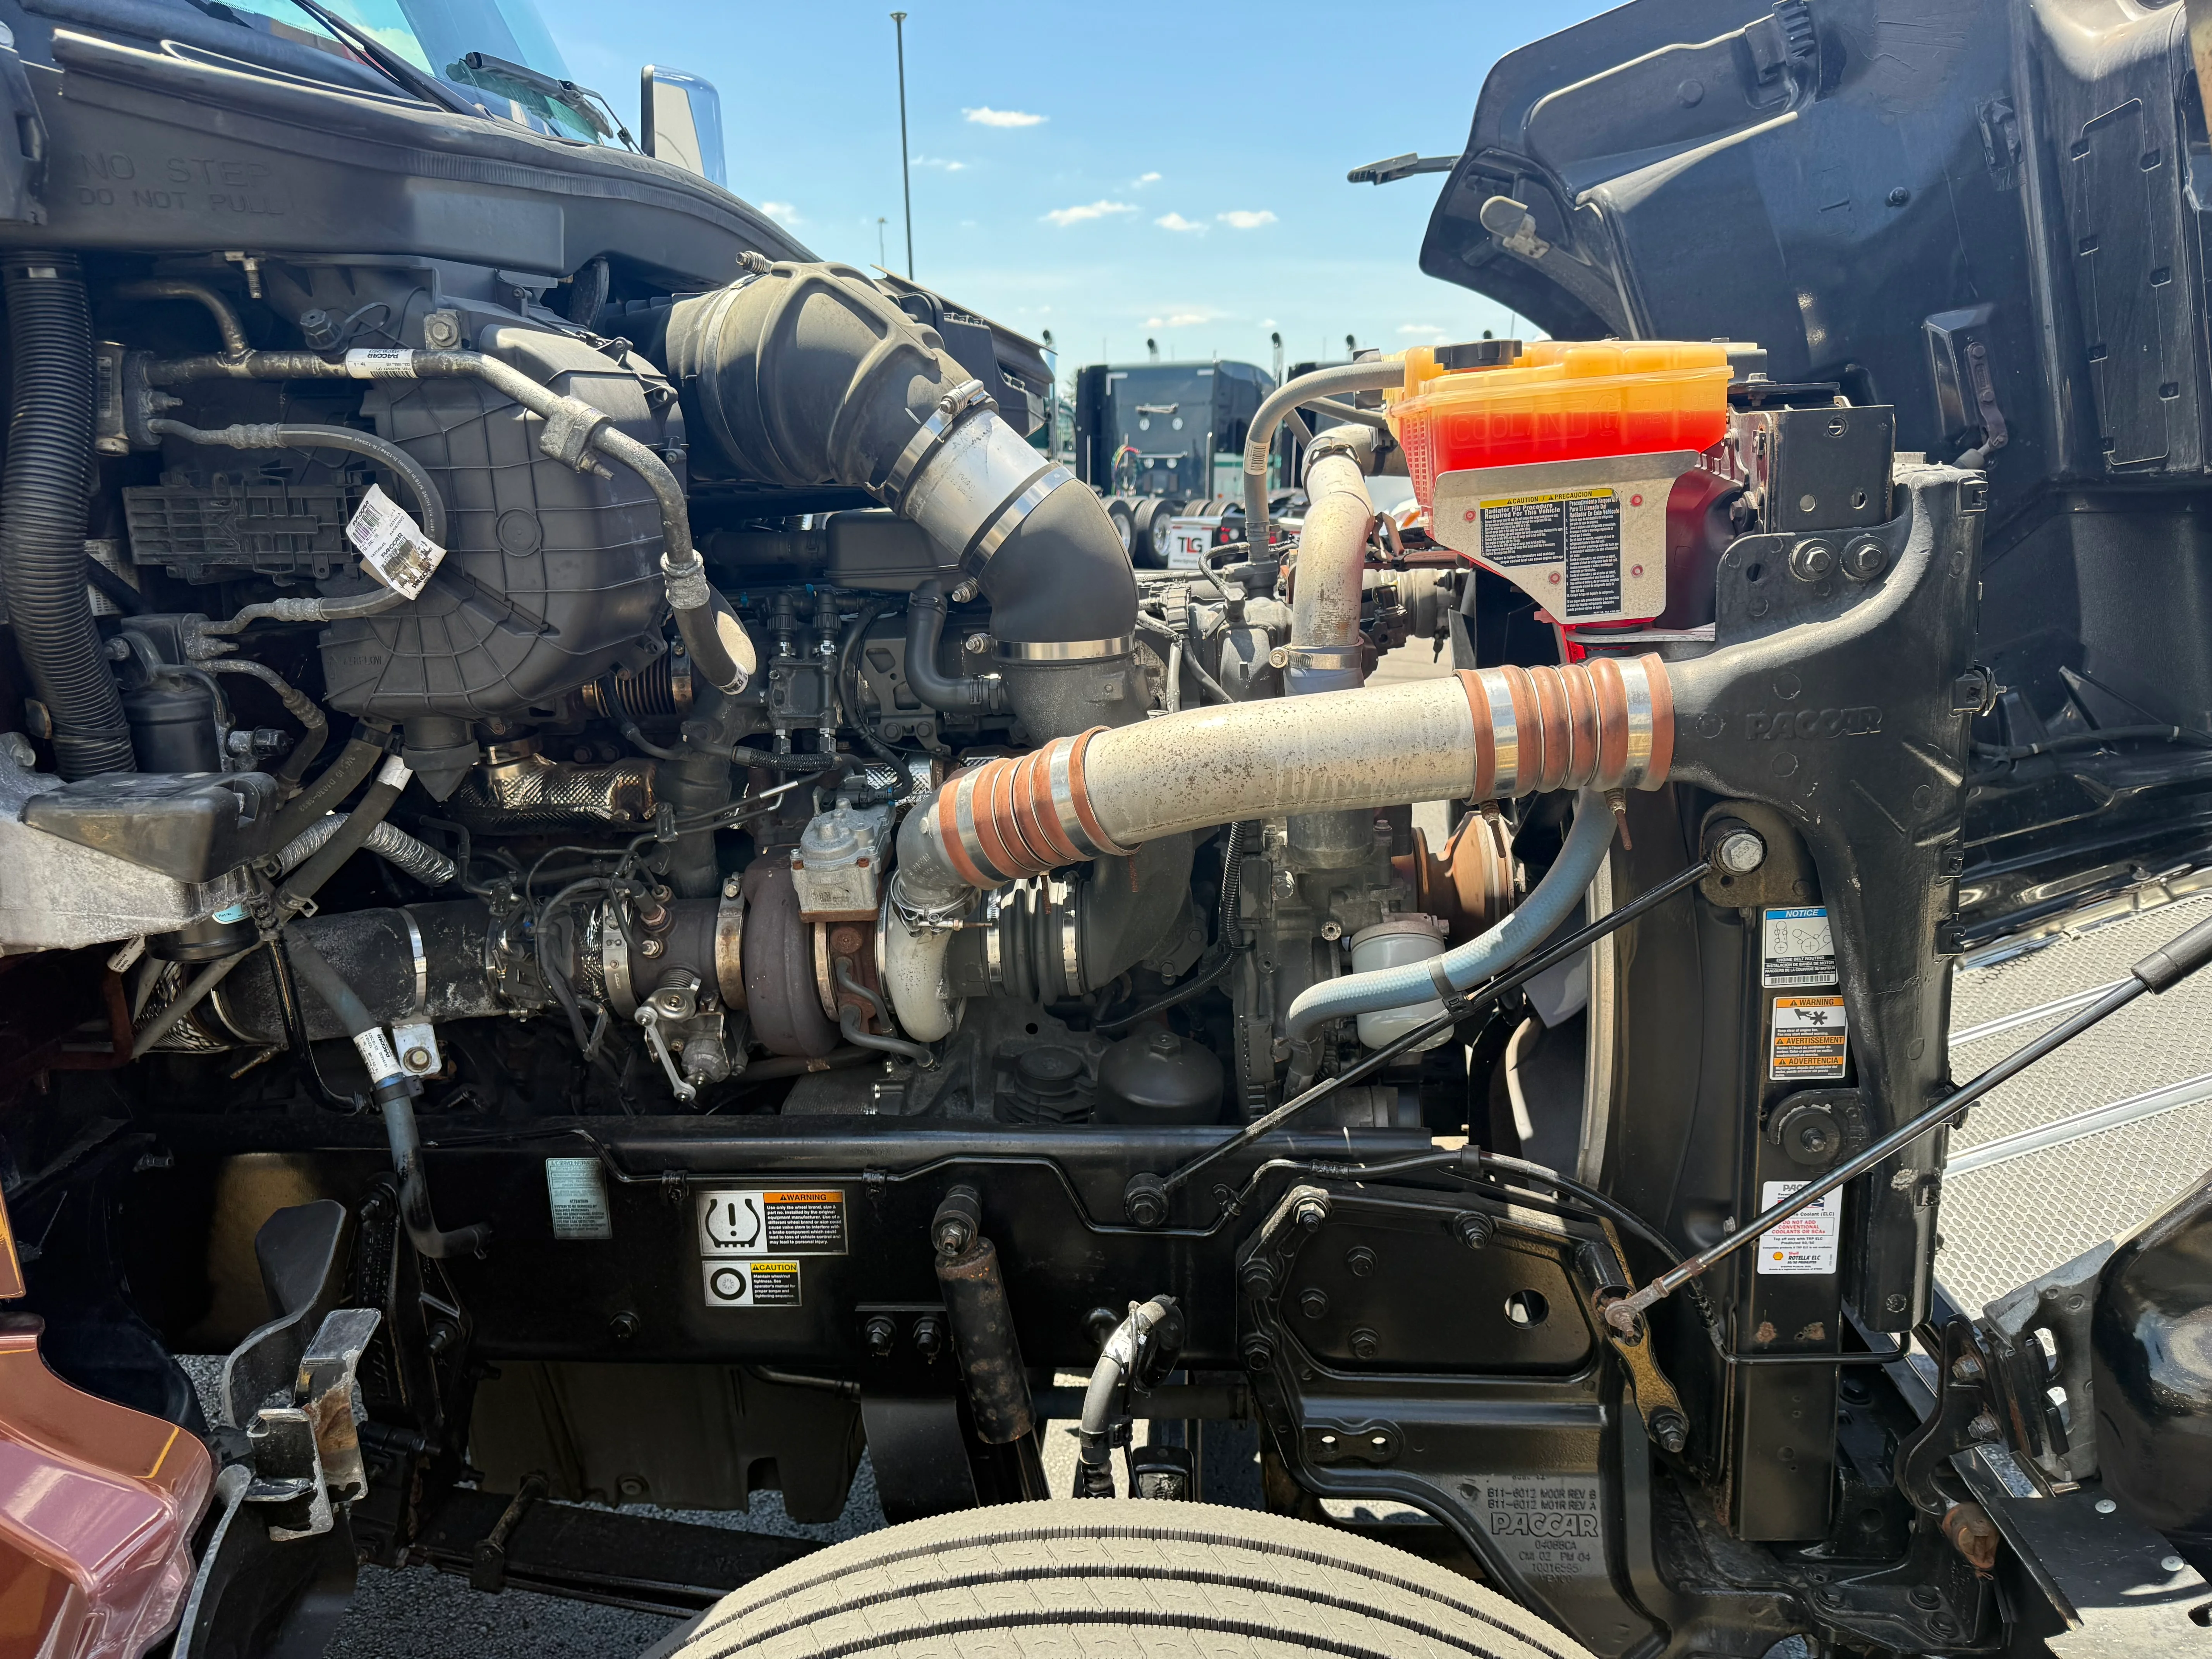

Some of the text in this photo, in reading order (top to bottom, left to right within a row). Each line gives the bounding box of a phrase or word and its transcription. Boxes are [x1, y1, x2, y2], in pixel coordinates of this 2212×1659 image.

[79, 151, 272, 188] NO STEP
[77, 186, 284, 215] DO NOT PULL
[1455, 411, 1578, 442] COOLANT
[422, 490, 431, 507] HOSE
[1554, 491, 1592, 500] PRECAUCION
[353, 500, 369, 526] PACCAR
[1523, 503, 1553, 512] Procedure
[389, 515, 404, 536] 04/06/2022
[381, 532, 403, 558] PACCAR
[1177, 536, 1202, 553] TLG
[1746, 706, 1882, 740] PACCAR
[1785, 909, 1819, 918] NOTICE
[377, 1034, 391, 1058] PACCAR
[1487, 1487, 1537, 1498] B11-6012
[1568, 1489, 1586, 1499] REV
[1589, 1489, 1596, 1499] B
[1487, 1499, 1537, 1510] B11-6012
[1568, 1499, 1586, 1510] REV
[1589, 1500, 1596, 1510] A
[1491, 1512, 1598, 1537] PACCAR
[1539, 1552, 1551, 1561] 02
[1577, 1553, 1591, 1562] 04
